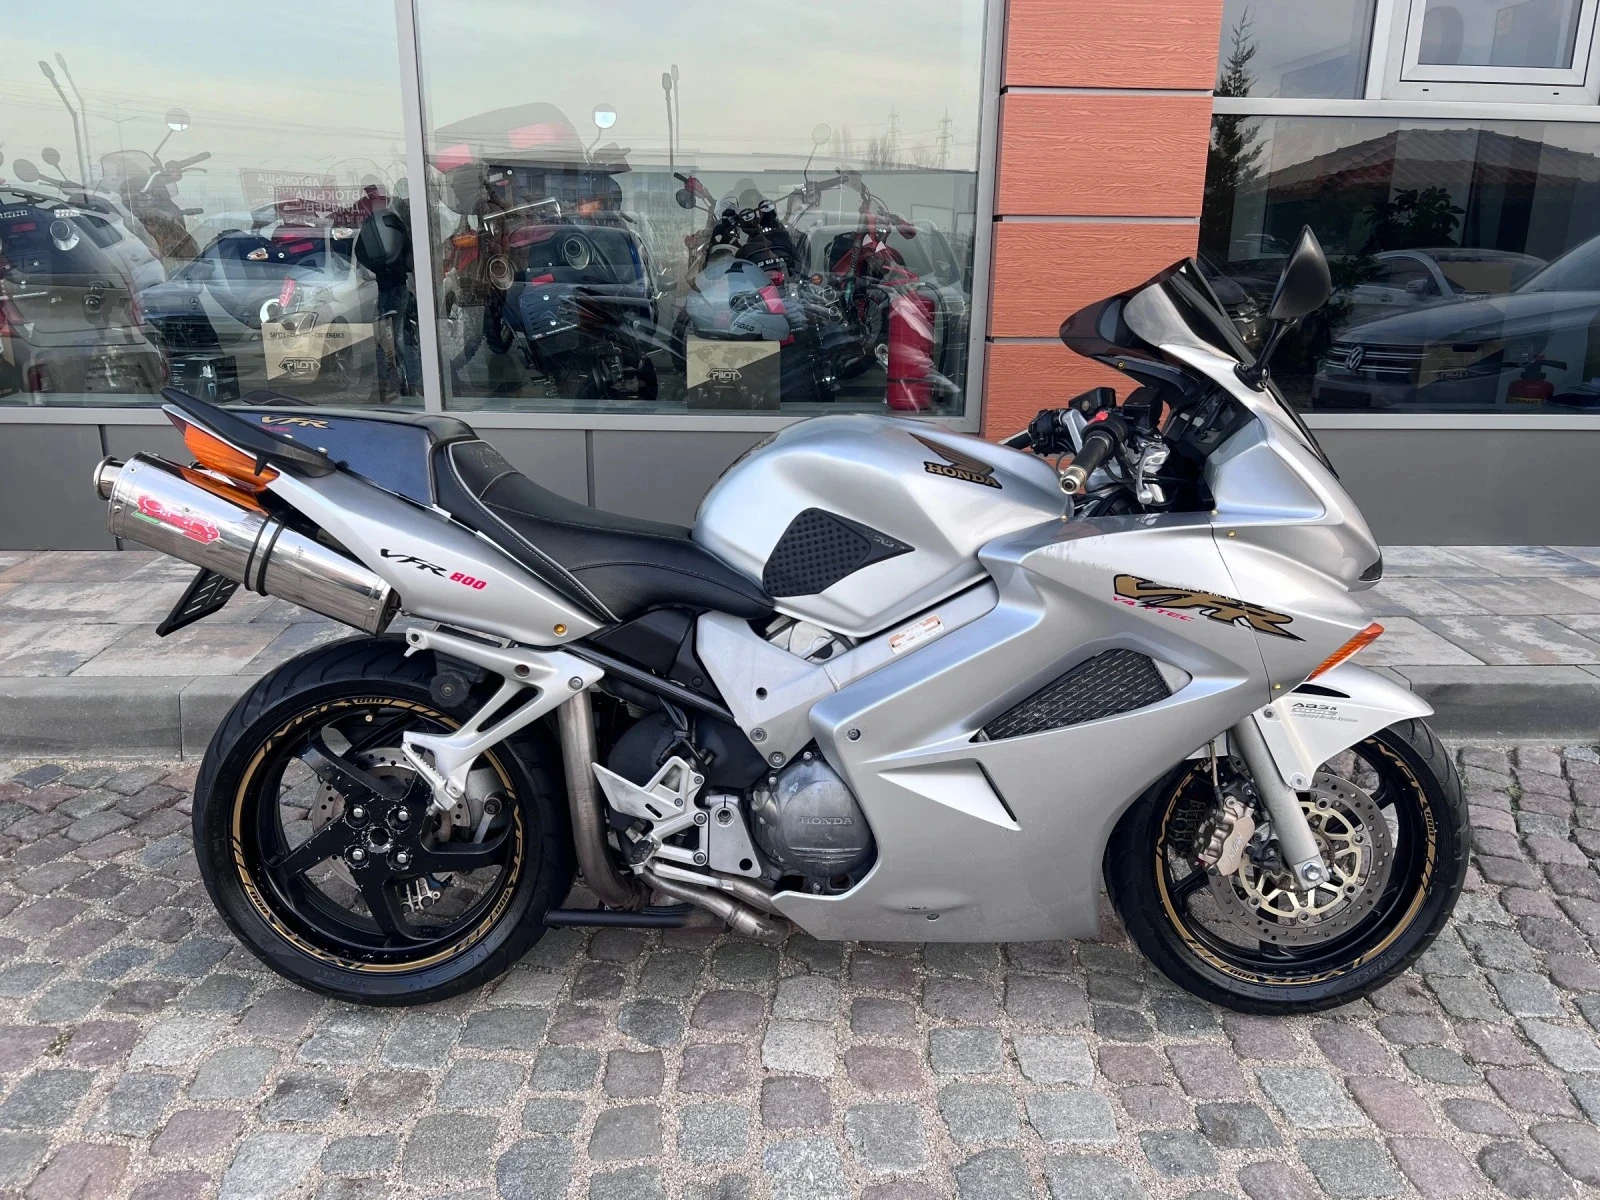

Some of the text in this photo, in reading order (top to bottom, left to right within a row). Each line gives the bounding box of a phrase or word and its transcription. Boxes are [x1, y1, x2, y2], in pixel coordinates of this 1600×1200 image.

[925, 462, 1002, 489] HONDA
[380, 548, 488, 591] VFR 800
[1113, 573, 1307, 642] VFR
[799, 815, 855, 826] HONDA
